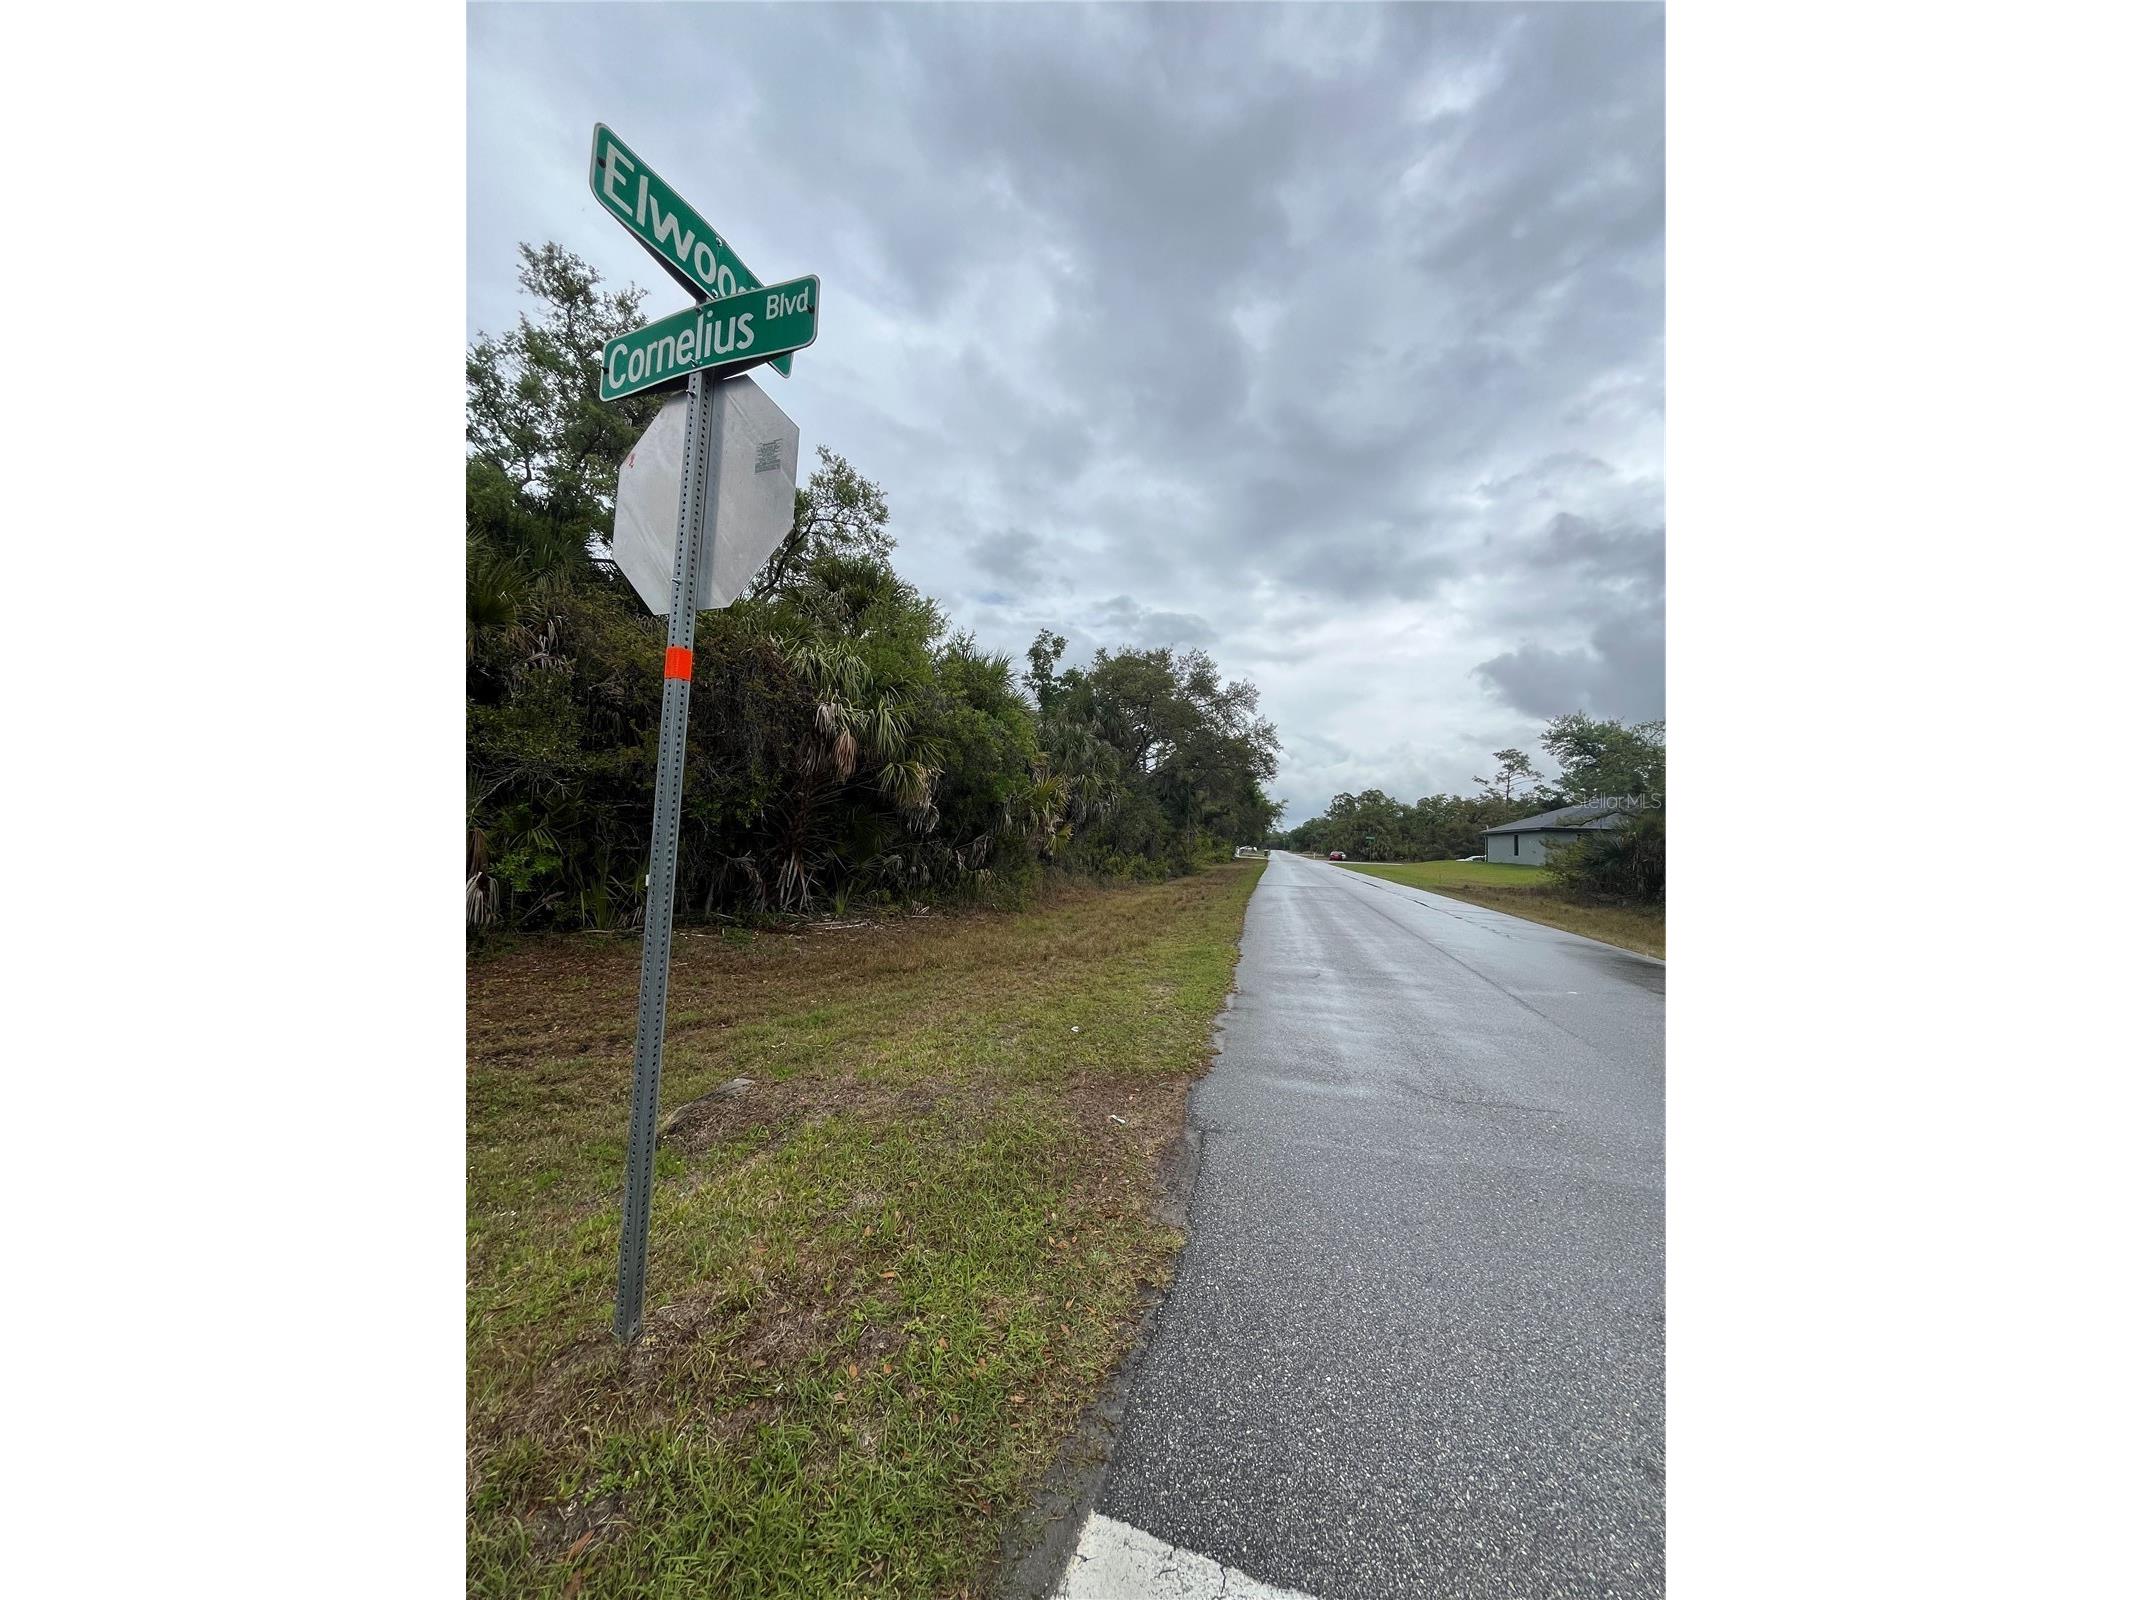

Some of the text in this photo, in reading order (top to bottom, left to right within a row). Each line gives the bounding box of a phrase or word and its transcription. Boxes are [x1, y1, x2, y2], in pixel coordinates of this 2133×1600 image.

[602, 140, 756, 298] Elwoo
[608, 286, 809, 389] Cornelius Blvd
